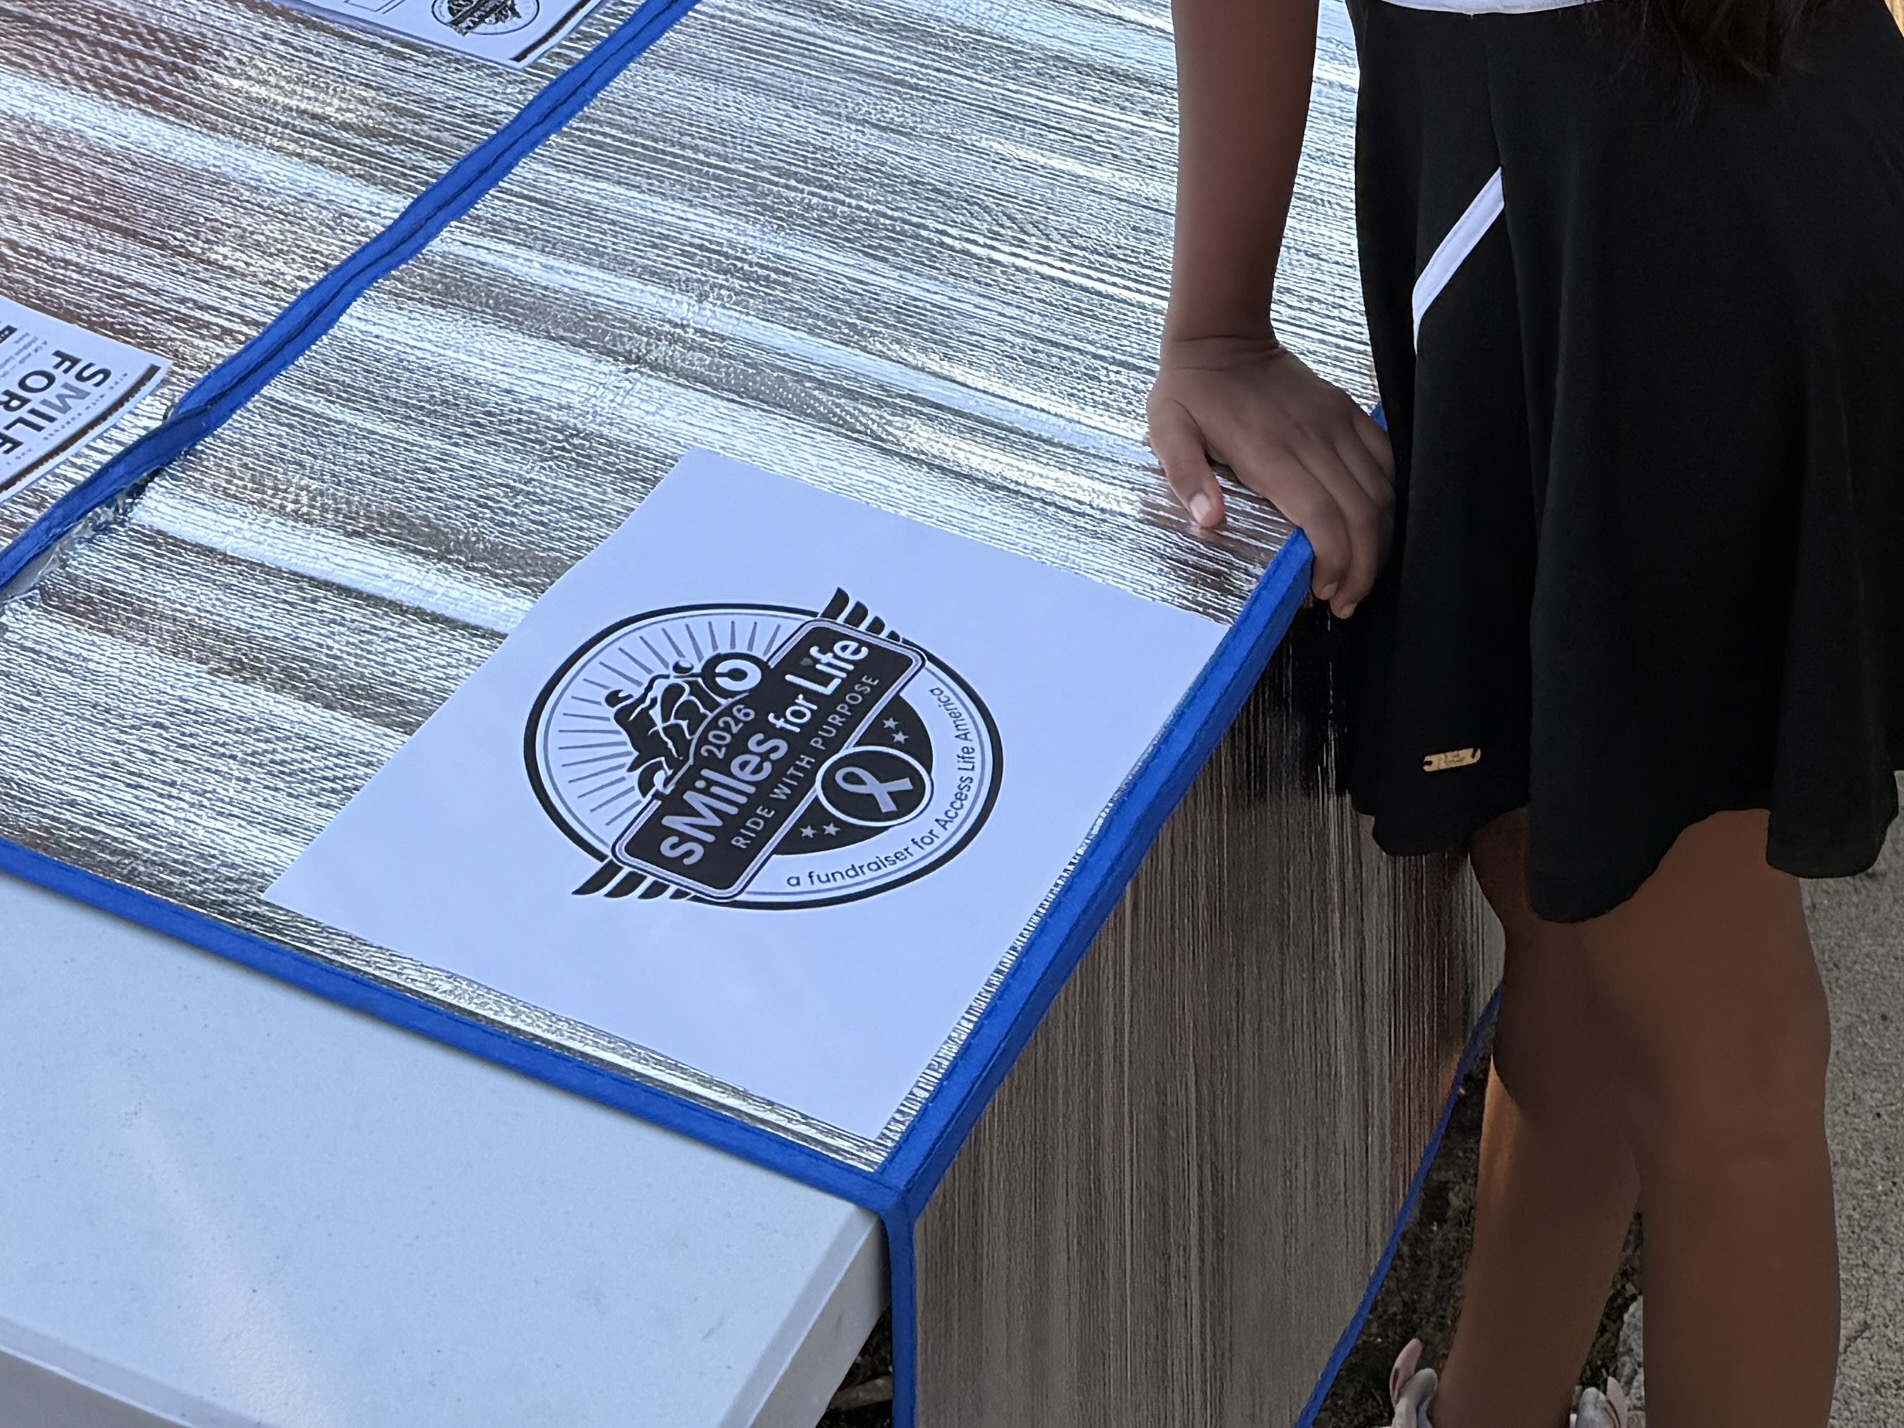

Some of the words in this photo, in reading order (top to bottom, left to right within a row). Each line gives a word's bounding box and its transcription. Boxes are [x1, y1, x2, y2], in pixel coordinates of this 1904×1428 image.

[785, 640, 869, 696] Life
[700, 704, 756, 760] 2026
[768, 693, 818, 733] for
[928, 687, 973, 742] America
[730, 805, 776, 849] RIDE
[769, 754, 816, 800] WITH
[810, 674, 880, 750] PURPOSE
[957, 746, 976, 773] Life
[659, 732, 789, 866] sMiles
[934, 775, 974, 831] Access
[808, 846, 913, 886] fundraiser
[911, 829, 941, 852] for
[786, 873, 801, 888] a
